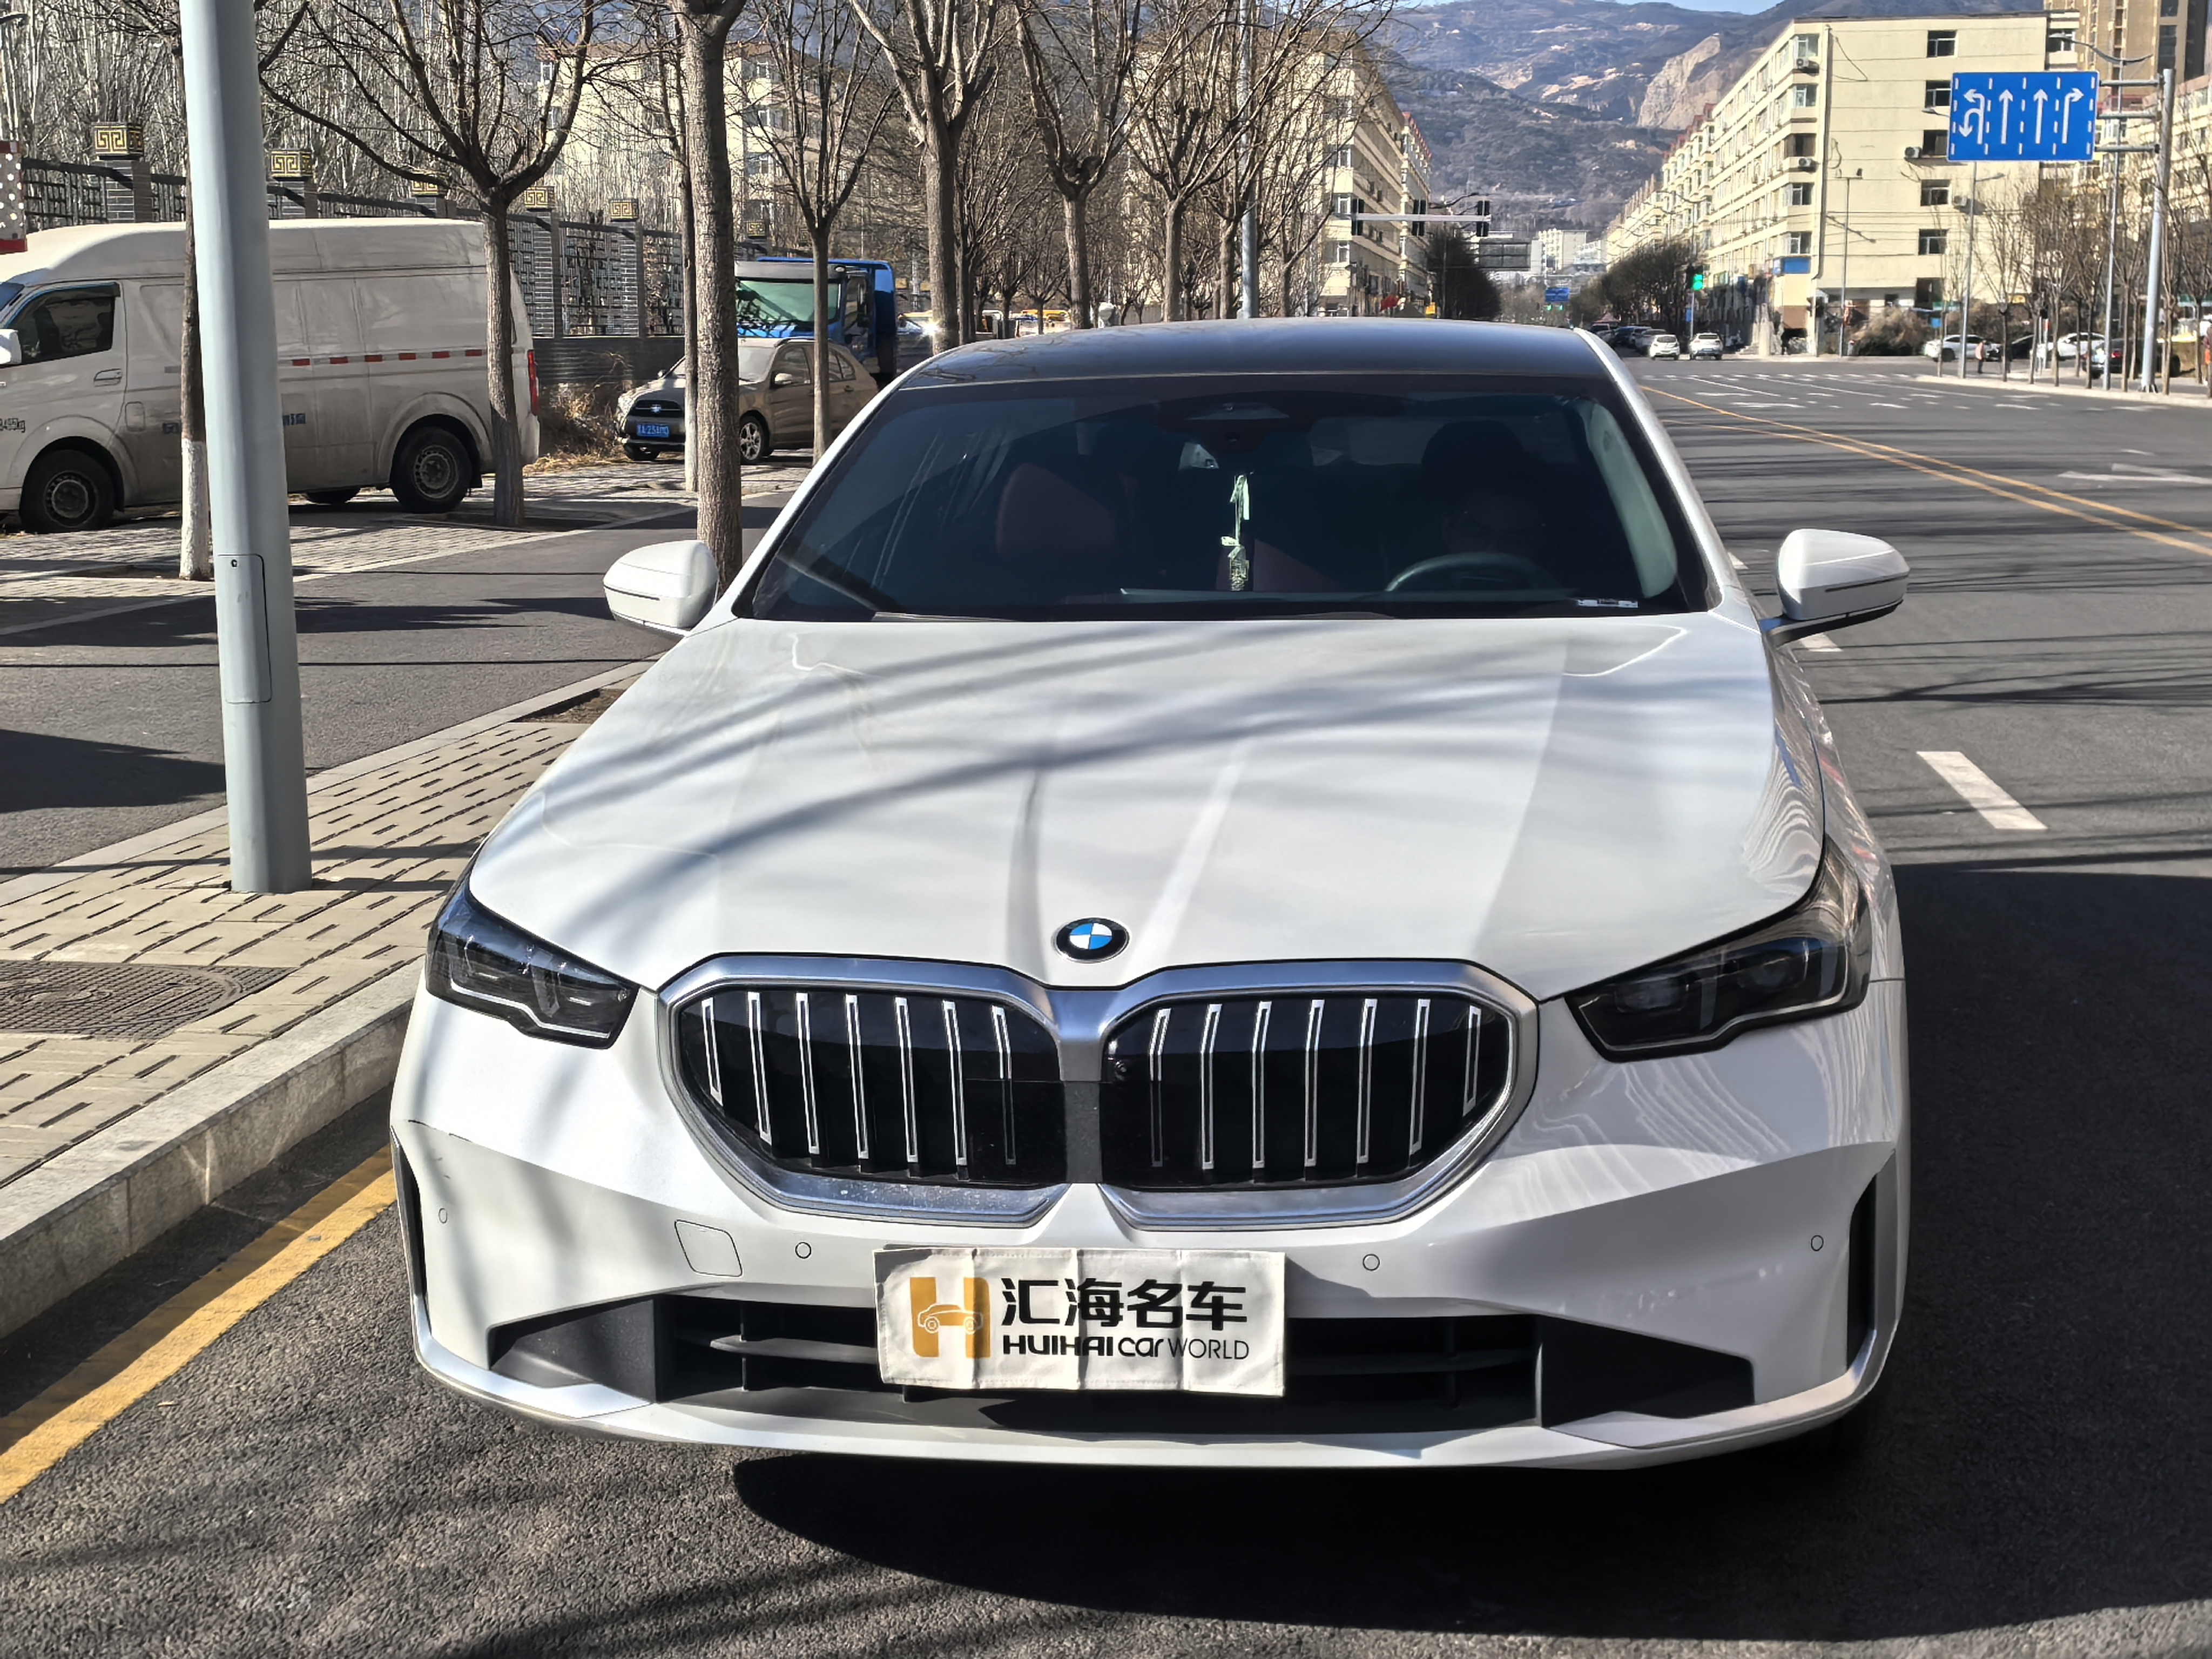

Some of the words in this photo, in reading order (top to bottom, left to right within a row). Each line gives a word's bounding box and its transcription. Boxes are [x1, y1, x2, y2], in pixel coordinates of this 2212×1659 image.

[1001, 1278, 1247, 1331] 汇海名车
[1003, 1335, 1113, 1357] HUIHAI
[1168, 1338, 1250, 1360] WORLD
